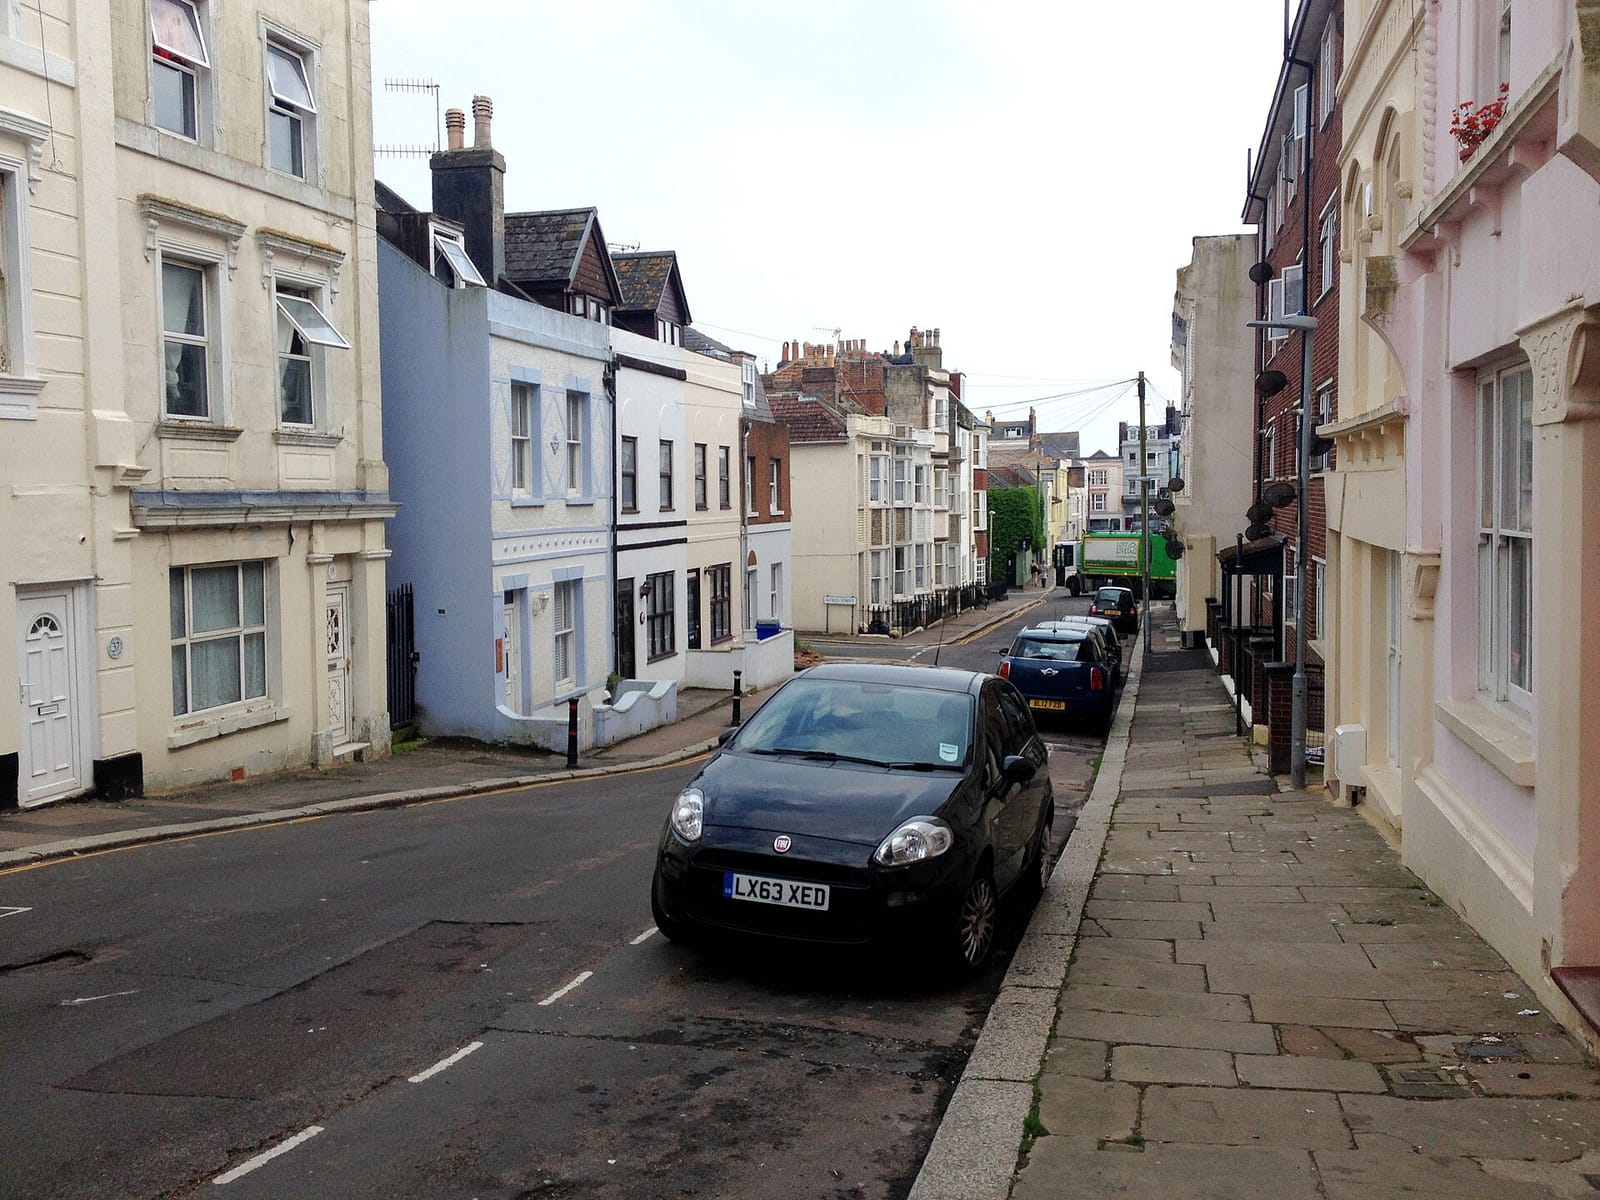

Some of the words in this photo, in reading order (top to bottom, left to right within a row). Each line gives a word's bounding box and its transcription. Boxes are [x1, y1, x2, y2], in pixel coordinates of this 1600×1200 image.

[112, 641, 120, 653] 37
[735, 877, 783, 902] LX63
[788, 885, 826, 907] XED
